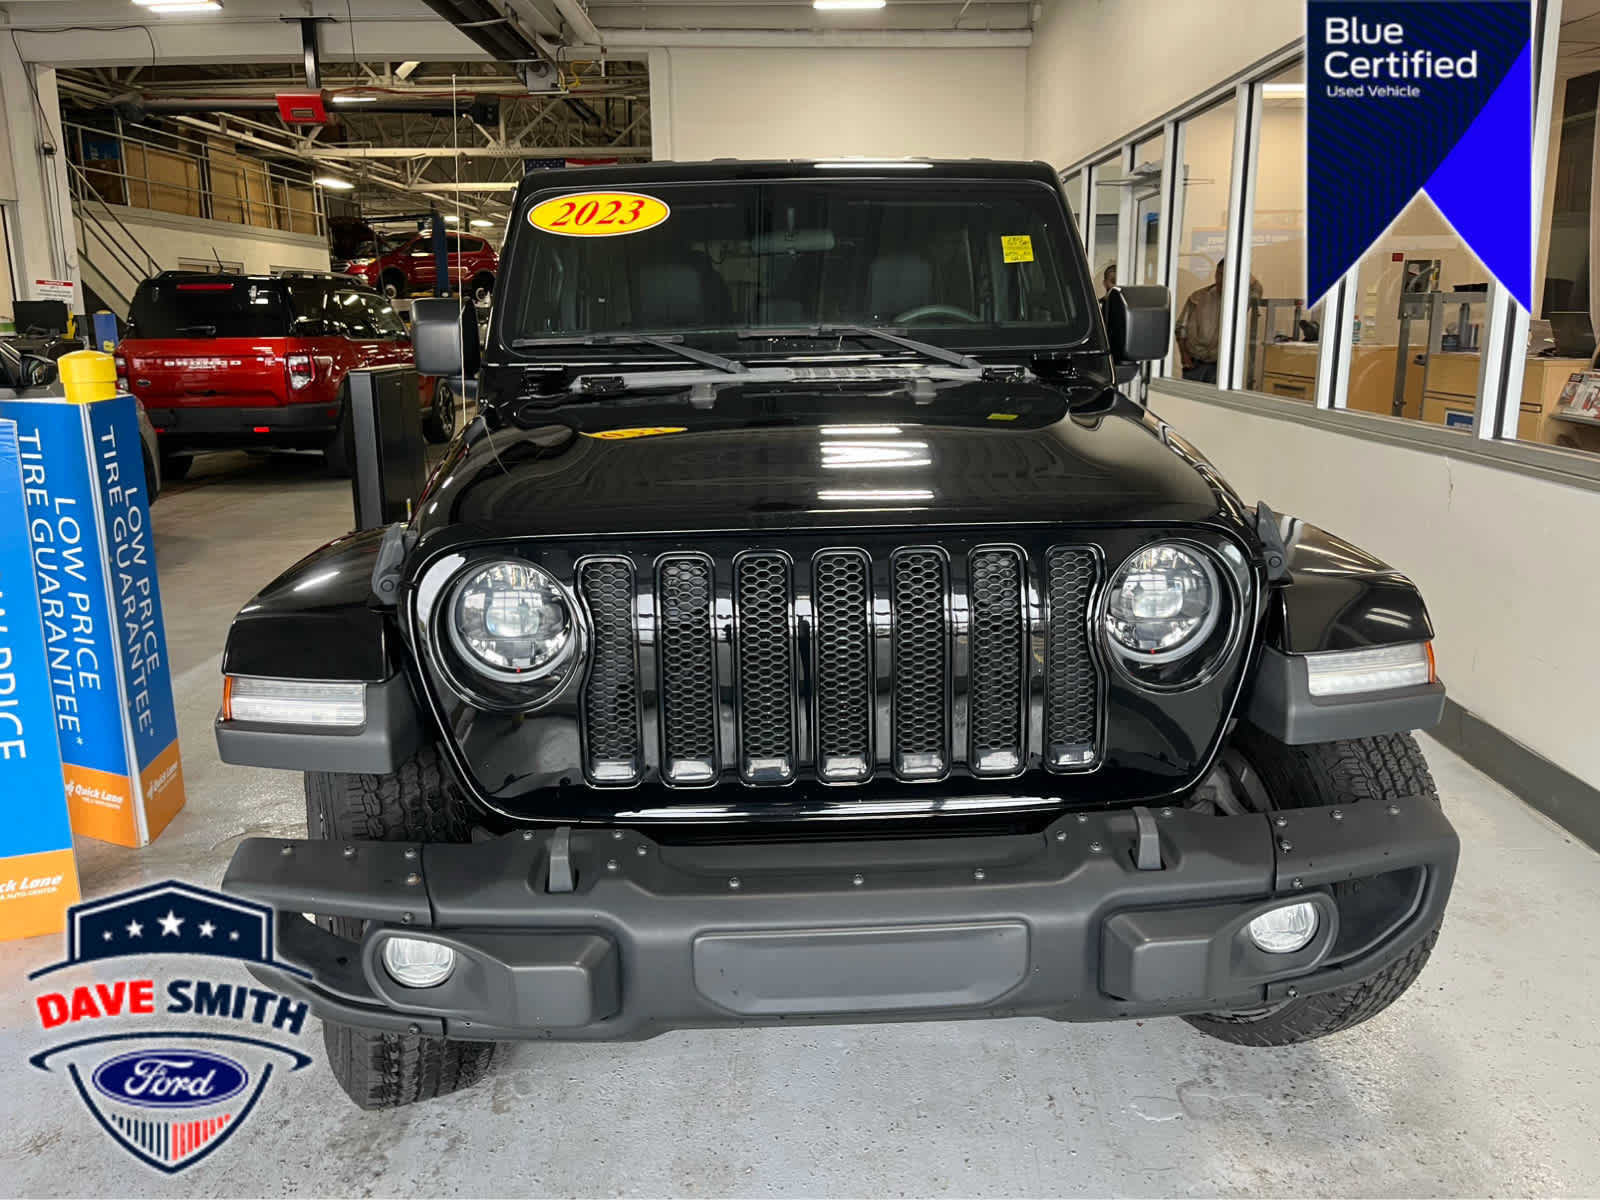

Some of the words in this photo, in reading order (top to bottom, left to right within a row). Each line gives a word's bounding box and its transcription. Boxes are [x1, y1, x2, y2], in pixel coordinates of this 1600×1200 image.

[550, 200, 645, 227] 2023
[19, 427, 49, 507] TIRE
[101, 424, 123, 507] TIRE
[54, 497, 87, 582] LOW
[125, 487, 147, 566] LOW
[136, 576, 160, 675] PRICE
[68, 591, 101, 691] PRICE
[75, 783, 100, 799] Quick
[19, 875, 63, 890] Lane
